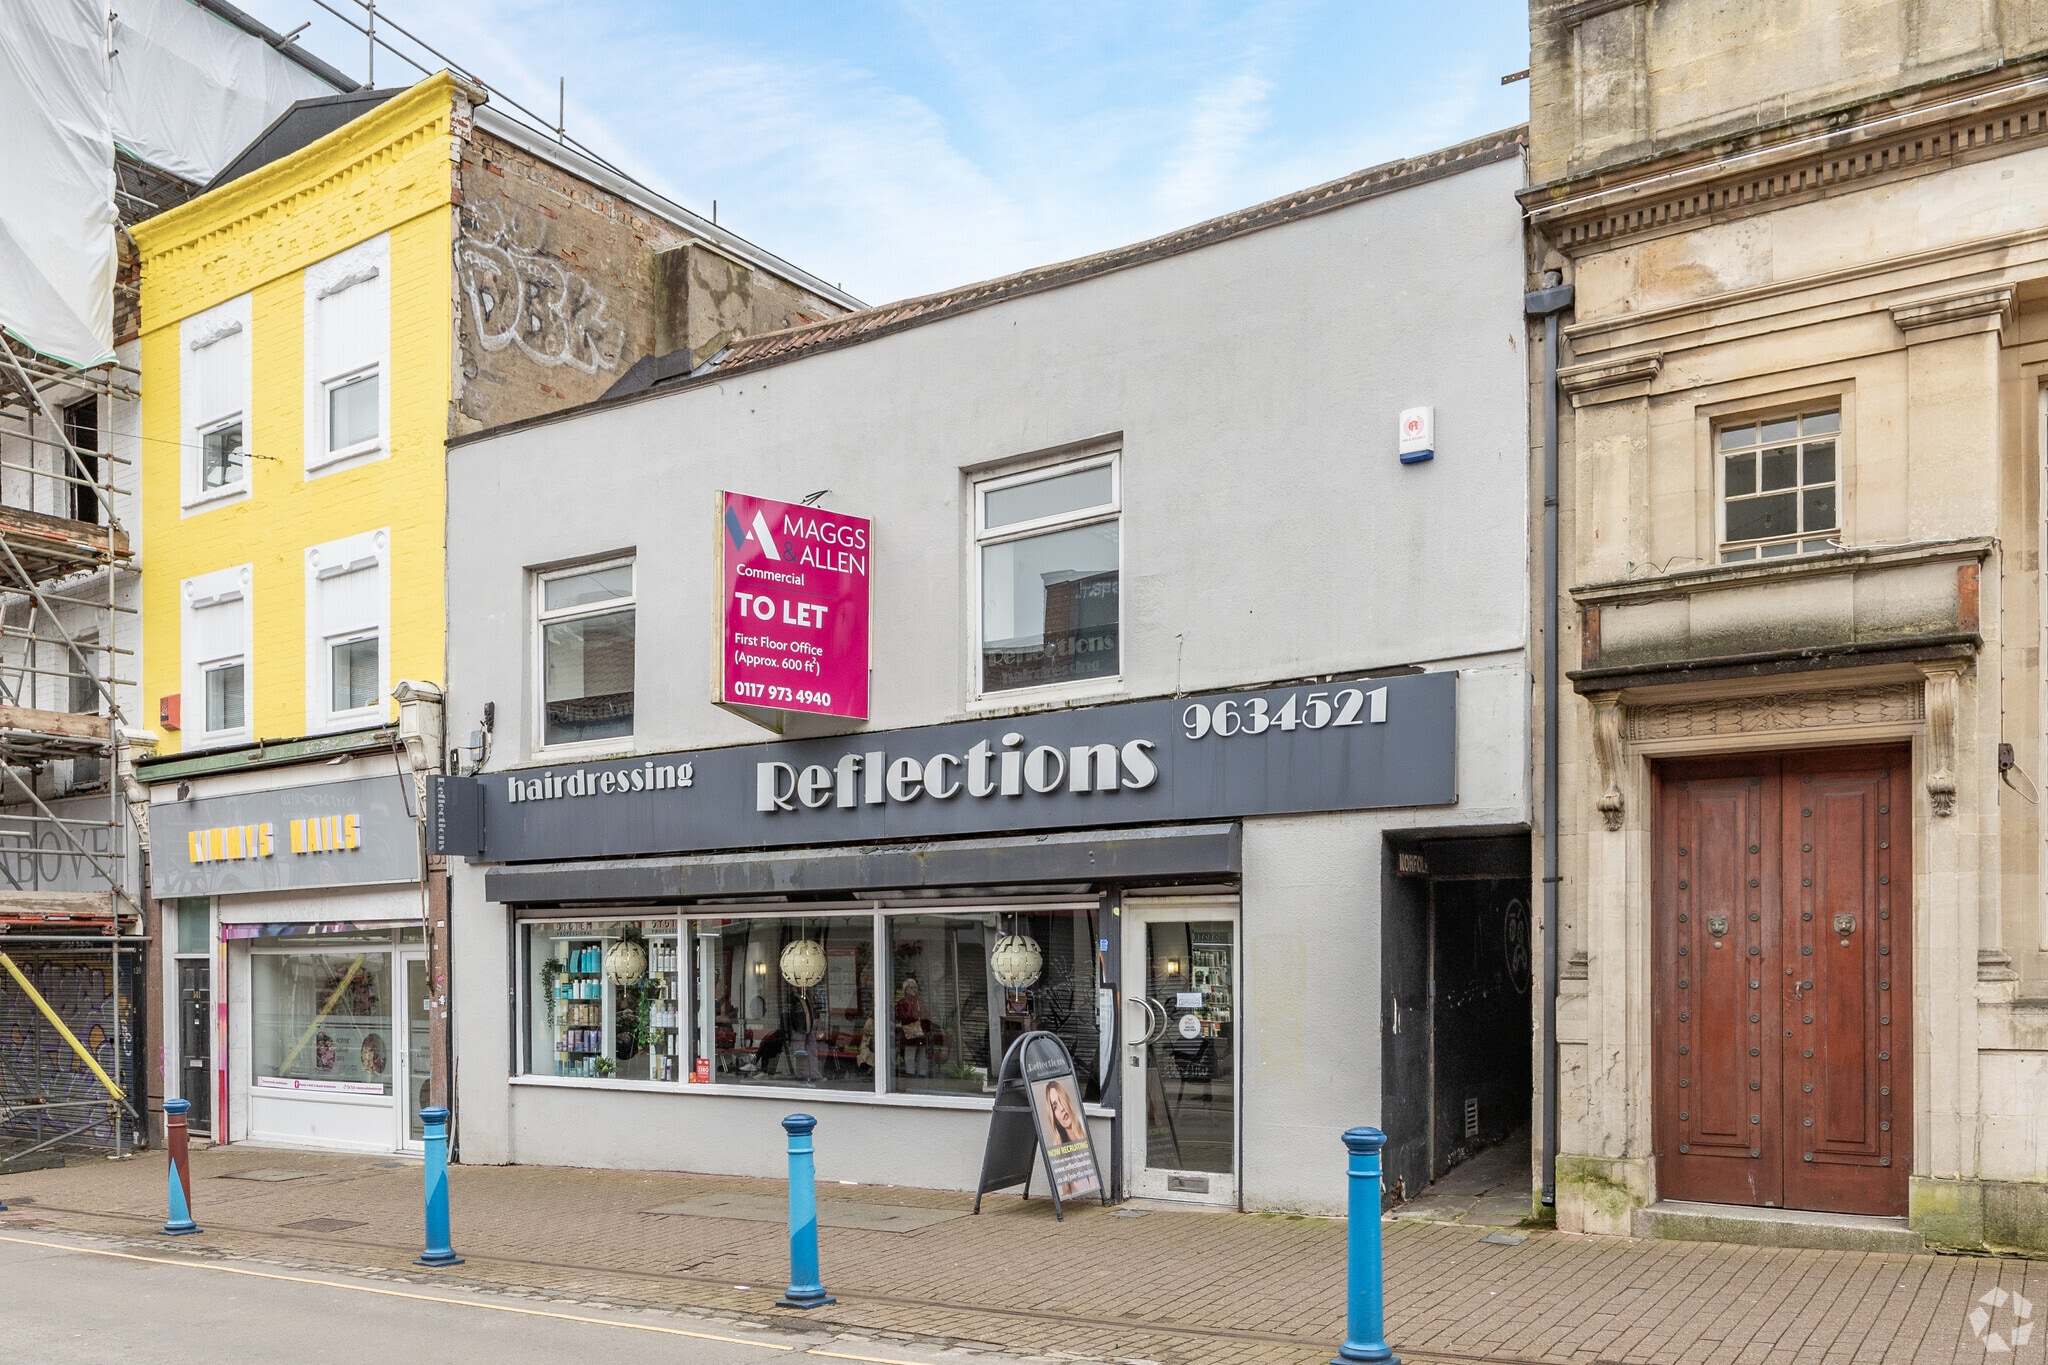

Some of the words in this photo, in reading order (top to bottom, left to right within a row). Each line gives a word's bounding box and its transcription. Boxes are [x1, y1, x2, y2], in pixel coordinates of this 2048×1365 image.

[783, 514, 866, 548] MAGGS
[736, 564, 805, 586] Commercial
[783, 541, 797, 563] &
[799, 546, 865, 577] ALLEN
[735, 592, 775, 621] TO
[783, 599, 828, 629] LET
[734, 649, 779, 669] (Approx.
[781, 658, 802, 671] 600
[735, 633, 758, 647] First
[760, 636, 787, 651] Floor
[790, 640, 823, 656] Office
[734, 681, 764, 698] 0117
[768, 685, 793, 701] 973
[796, 689, 831, 707] 4940
[1182, 686, 1388, 740] 9634521
[508, 760, 694, 803] hairdressing
[756, 732, 1159, 812] Reflections
[437, 777, 446, 851] Reflections
[188, 822, 274, 863] KIMMYS
[290, 813, 361, 854] NAILS
[1047, 1147, 1061, 1158] NOW
[1060, 1140, 1089, 1155] RECRUITING
